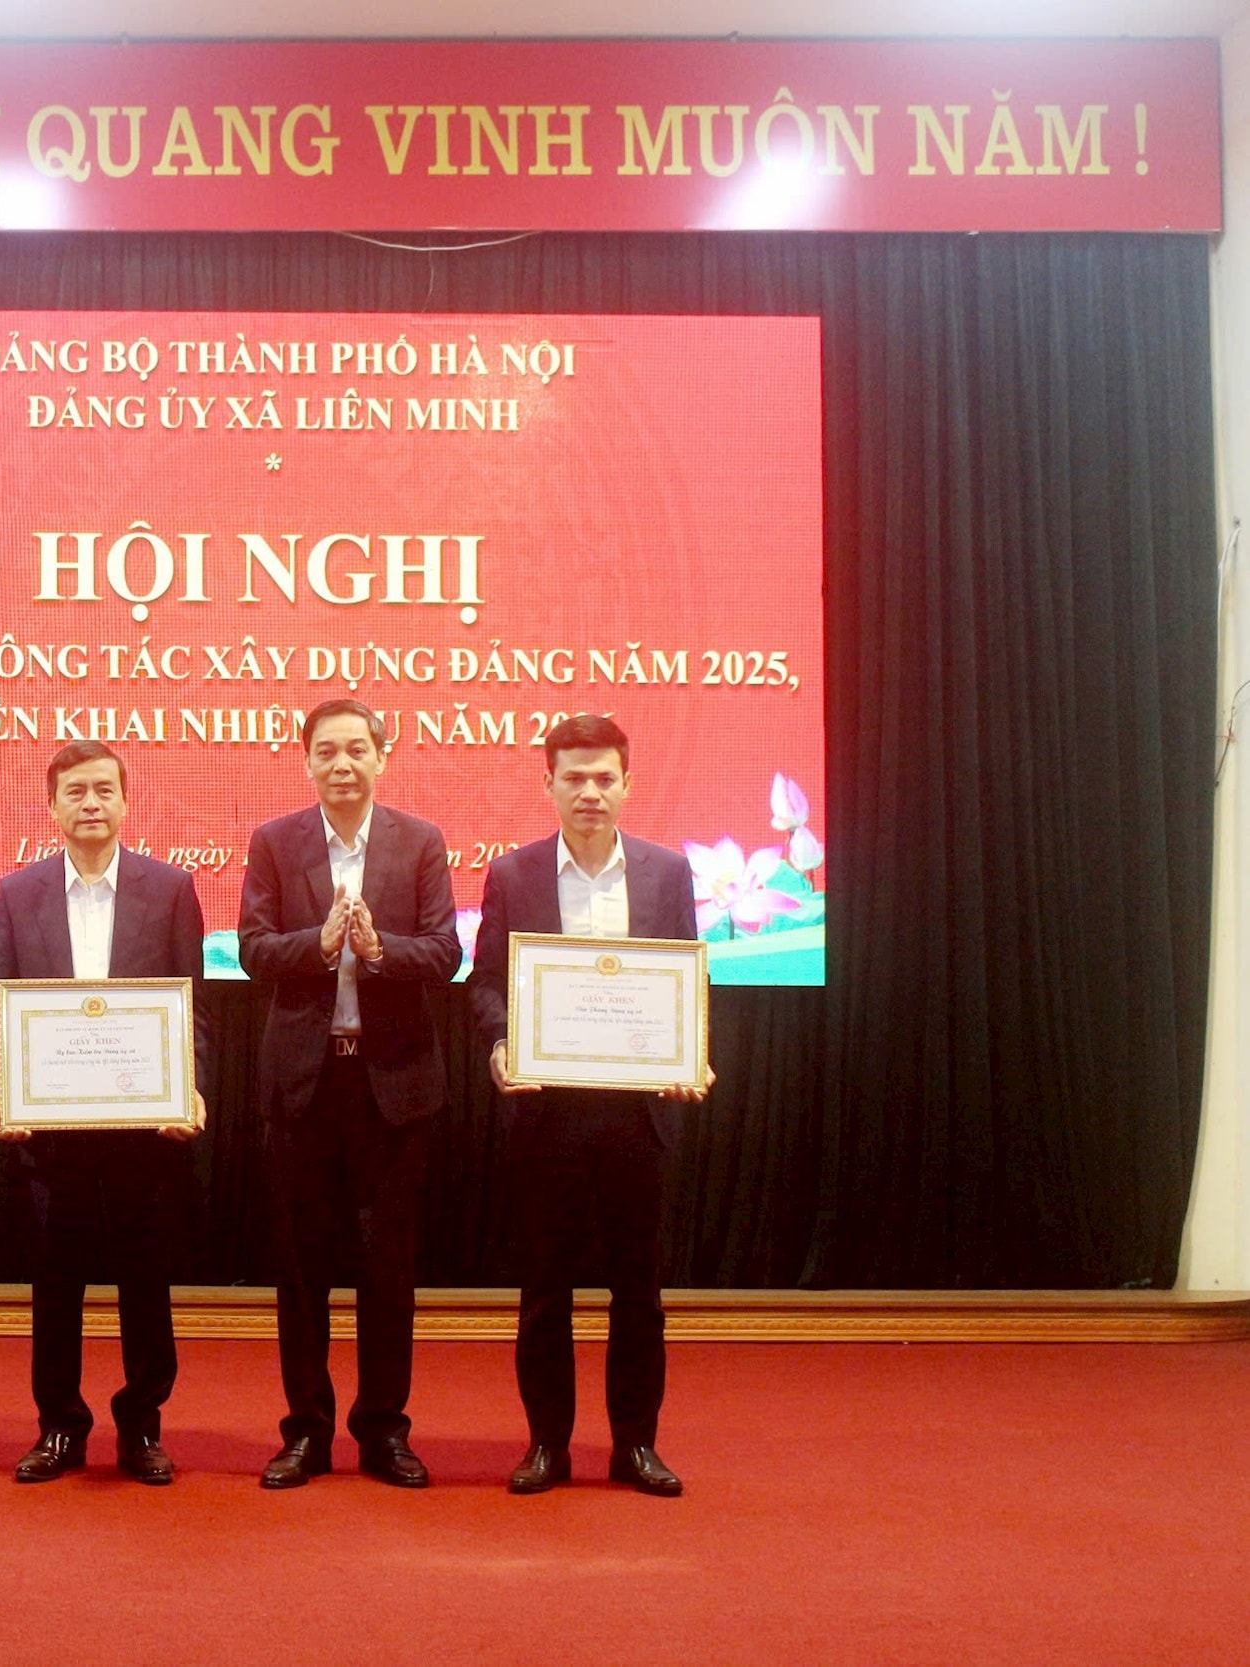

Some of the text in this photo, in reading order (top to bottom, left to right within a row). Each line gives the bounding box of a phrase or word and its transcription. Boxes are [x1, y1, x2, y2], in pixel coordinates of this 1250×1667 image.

[25, 104, 341, 182] QUANG
[365, 105, 593, 177] VINH
[616, 87, 880, 177] MUÔN
[907, 88, 1110, 177] NĂM
[102, 337, 160, 382] BỘ
[169, 333, 318, 376] THÀNH
[331, 334, 419, 376] PHỐ
[431, 335, 490, 377] HÀ
[501, 340, 577, 385] NỘI
[28, 387, 520, 432] ĐẢNG ỦY XÃ LIÊN MINH
[32, 520, 487, 626] HỘI NGHỊ
[101, 636, 192, 681] TÁC
[203, 636, 296, 681] XÂY
[307, 640, 437, 691] DỰNG
[448, 639, 575, 684] ĐẢNG
[588, 642, 690, 685] NĂM
[701, 650, 801, 691] 2025,
[54, 706, 166, 743] KHAI
[416, 702, 518, 747] NĂM
[15, 838, 67, 864] Liê
[167, 839, 234, 873] ngày
